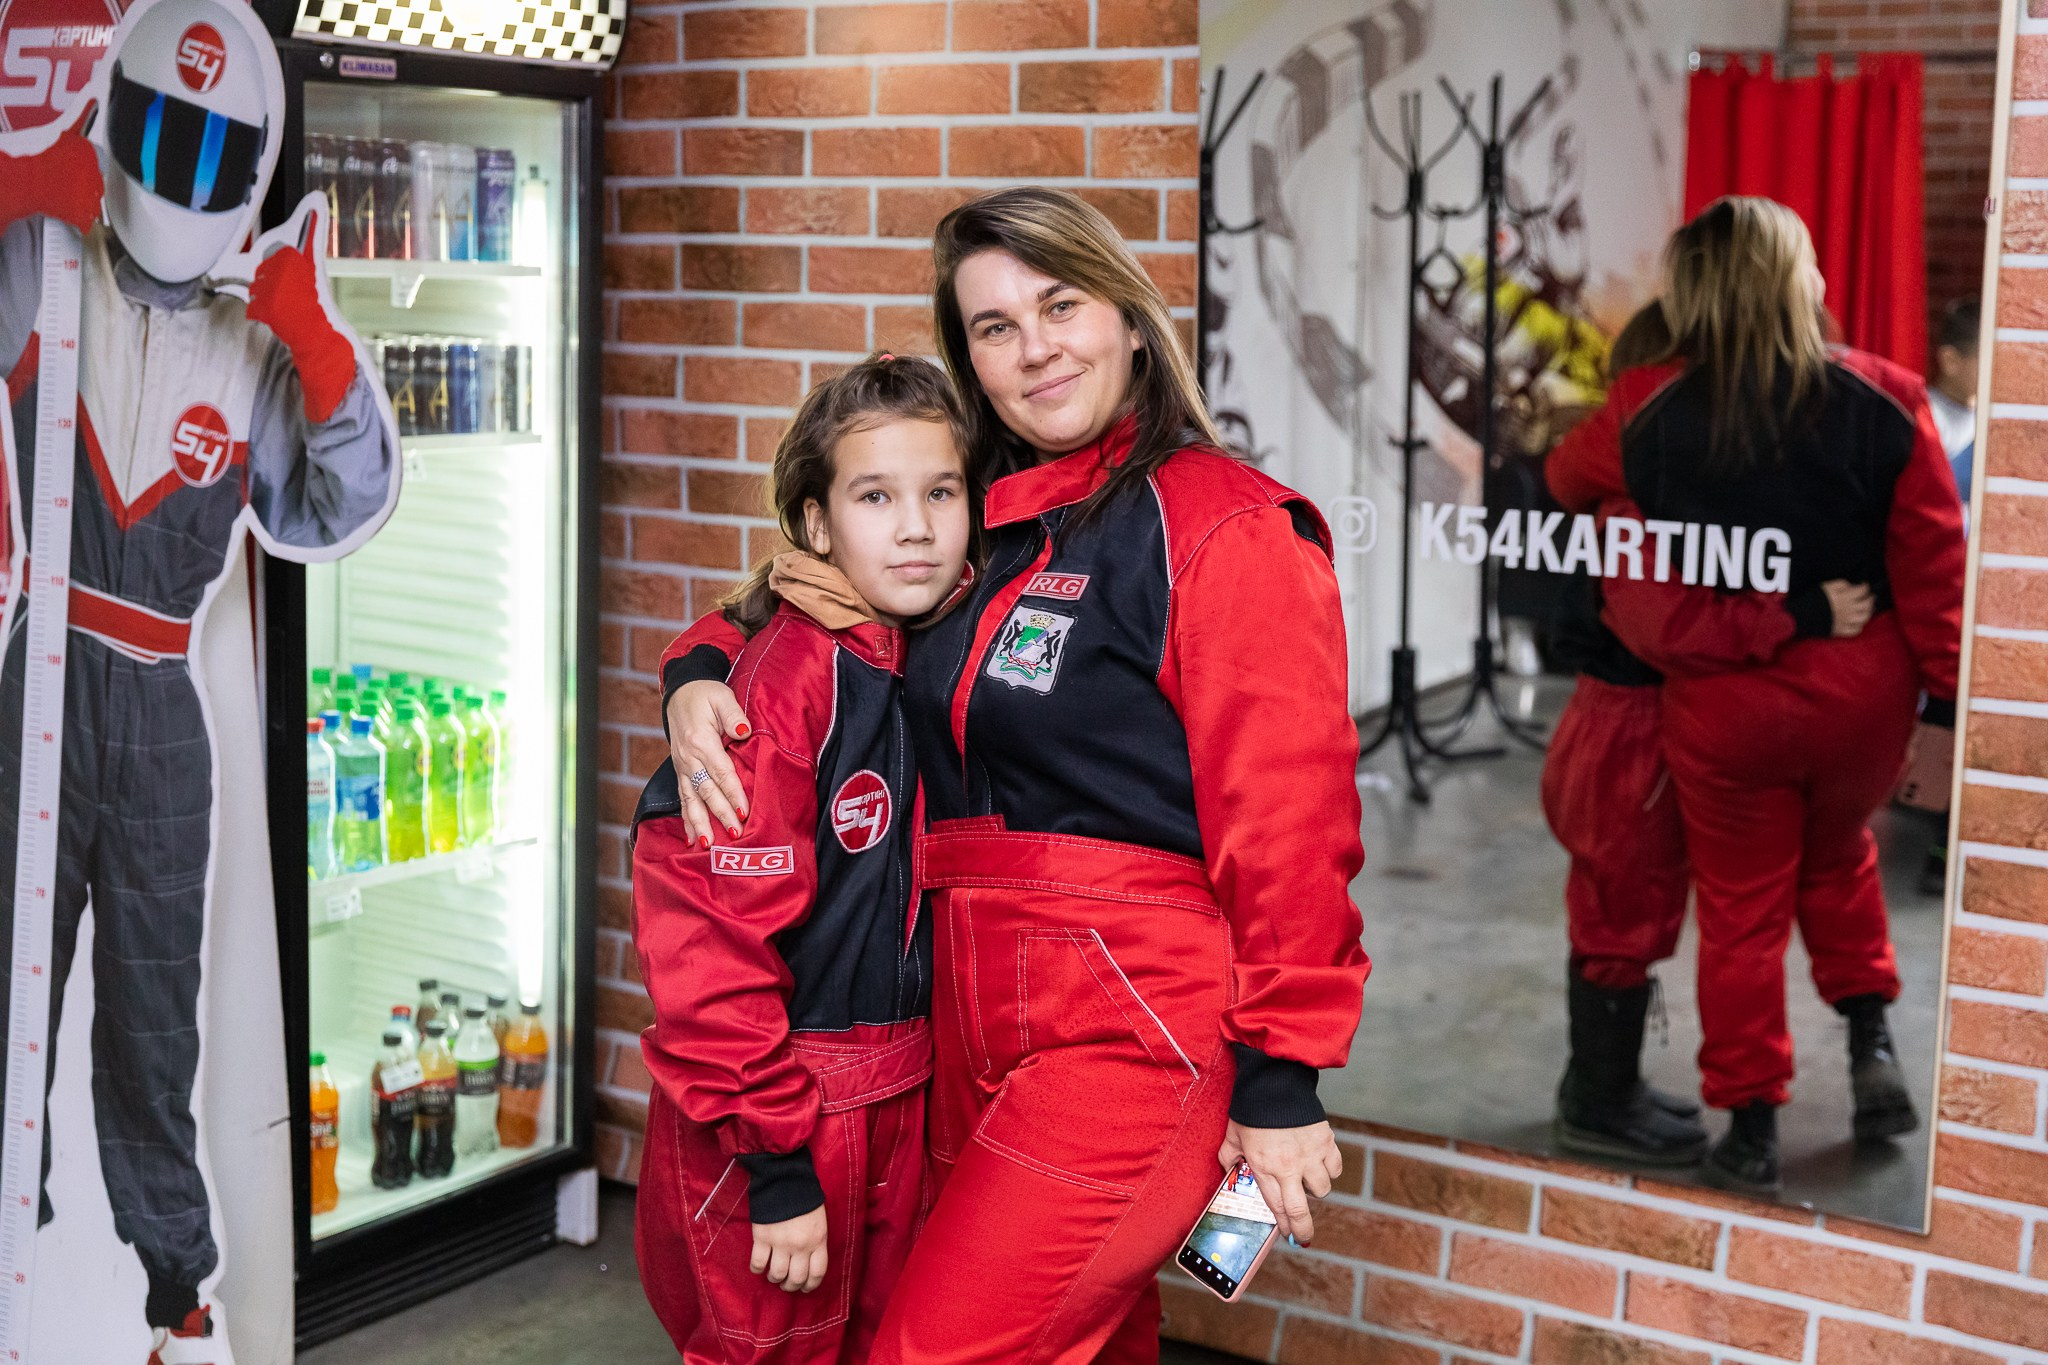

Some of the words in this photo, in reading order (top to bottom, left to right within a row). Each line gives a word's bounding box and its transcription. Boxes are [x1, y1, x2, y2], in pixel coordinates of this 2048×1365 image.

[1418, 501, 1792, 593] K54KARTING
[1032, 577, 1081, 594] RLG
[719, 853, 785, 869] RLG
